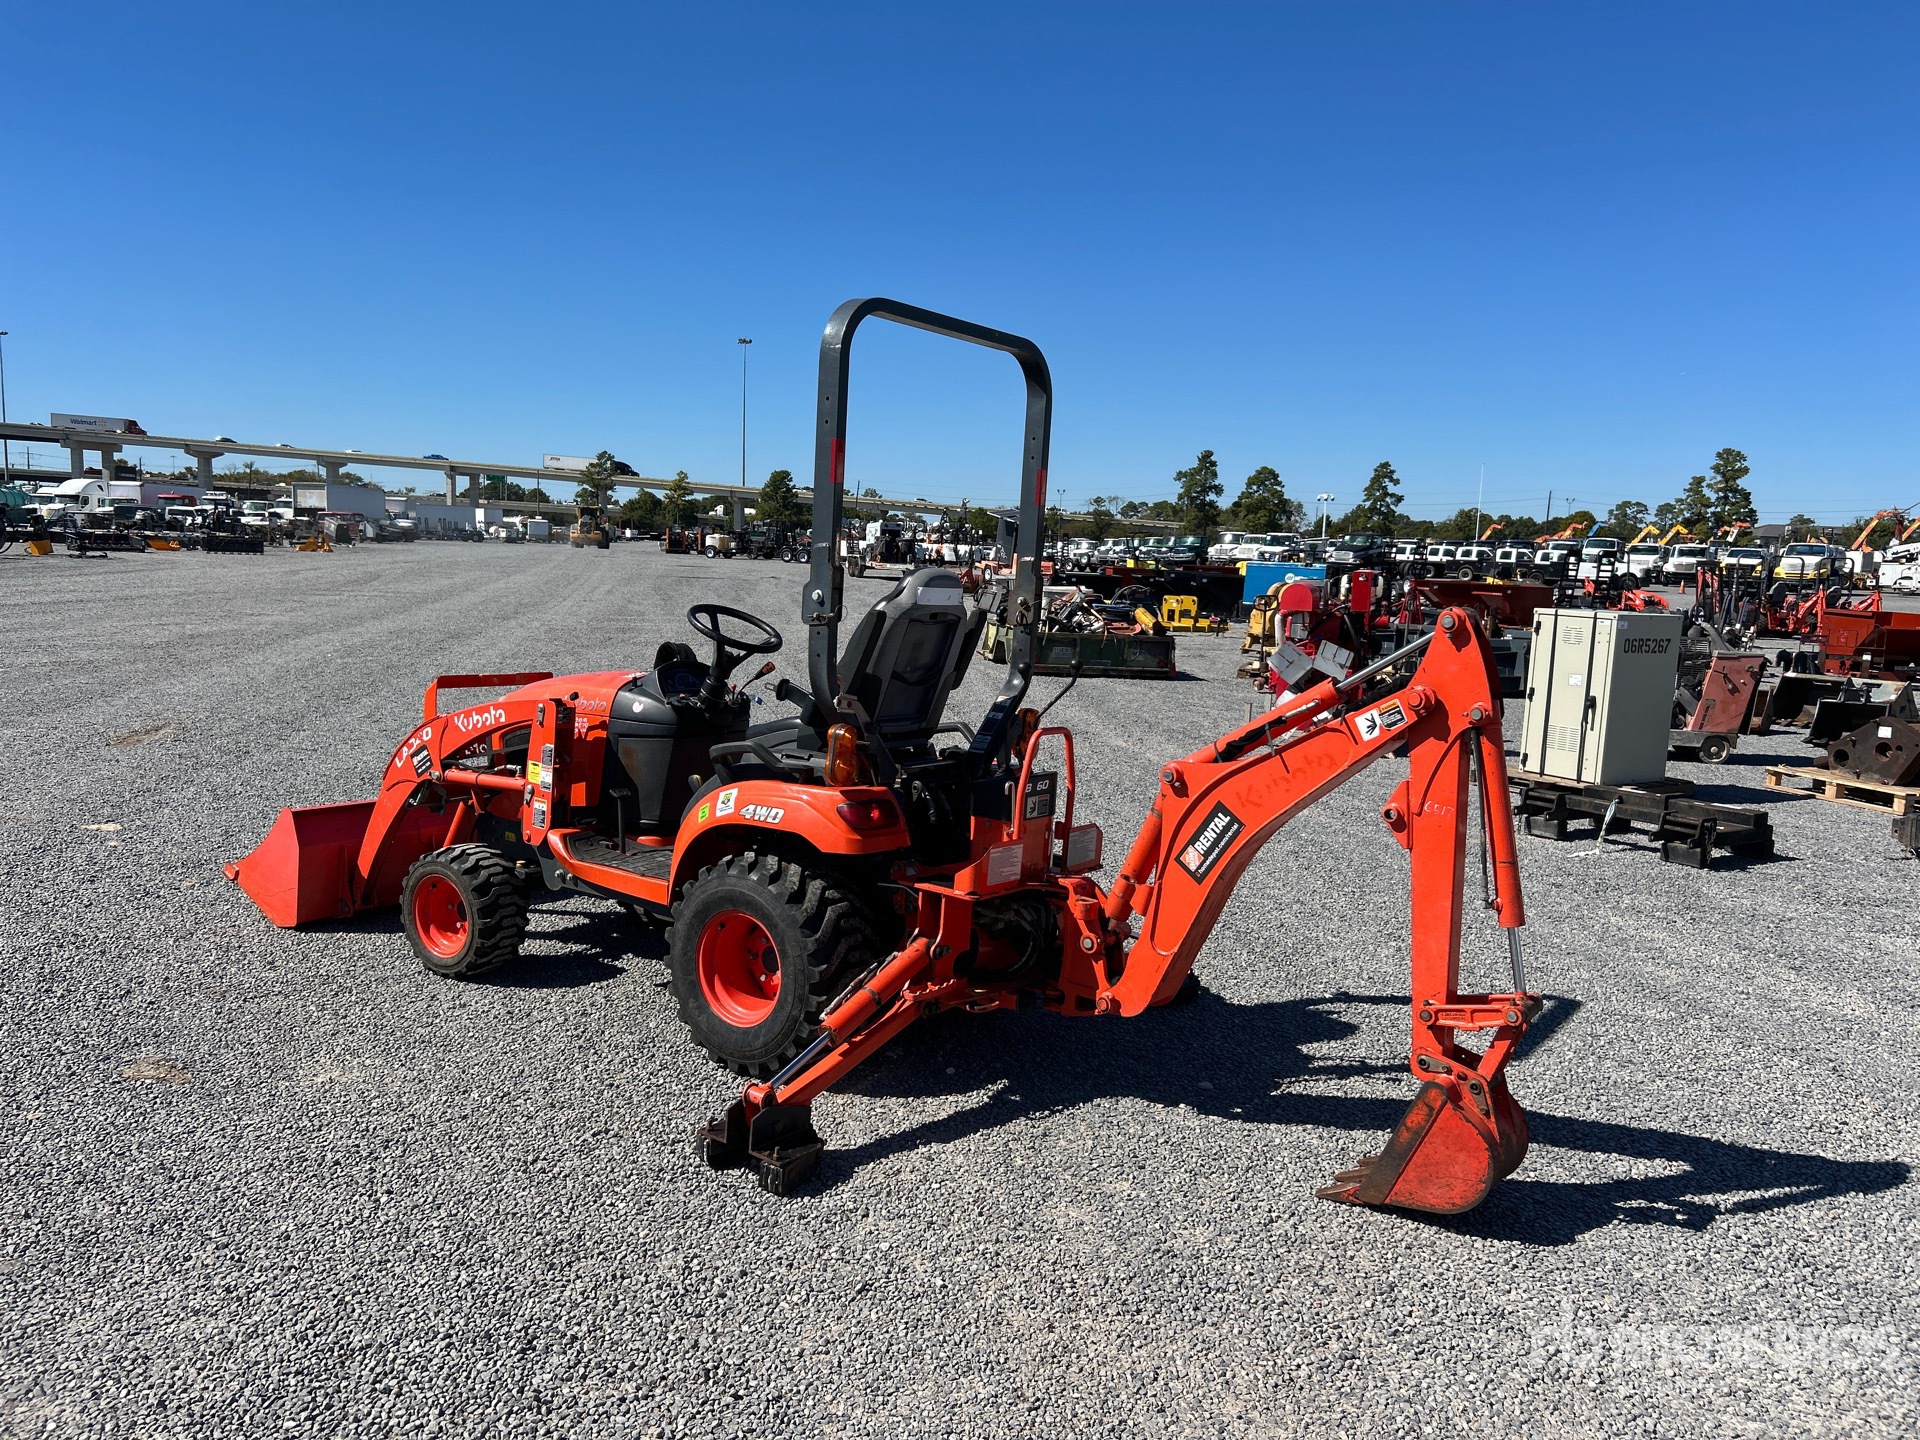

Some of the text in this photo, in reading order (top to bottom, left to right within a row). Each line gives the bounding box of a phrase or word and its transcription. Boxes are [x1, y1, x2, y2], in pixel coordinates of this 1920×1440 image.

[70, 418, 97, 426] Walmart
[1623, 638, 1672, 654] 06R5267
[454, 706, 506, 732] Kubota
[738, 803, 785, 824] 4WD
[1194, 812, 1231, 854] RENTAL
[1198, 822, 1239, 875] homedepot.com/rental
